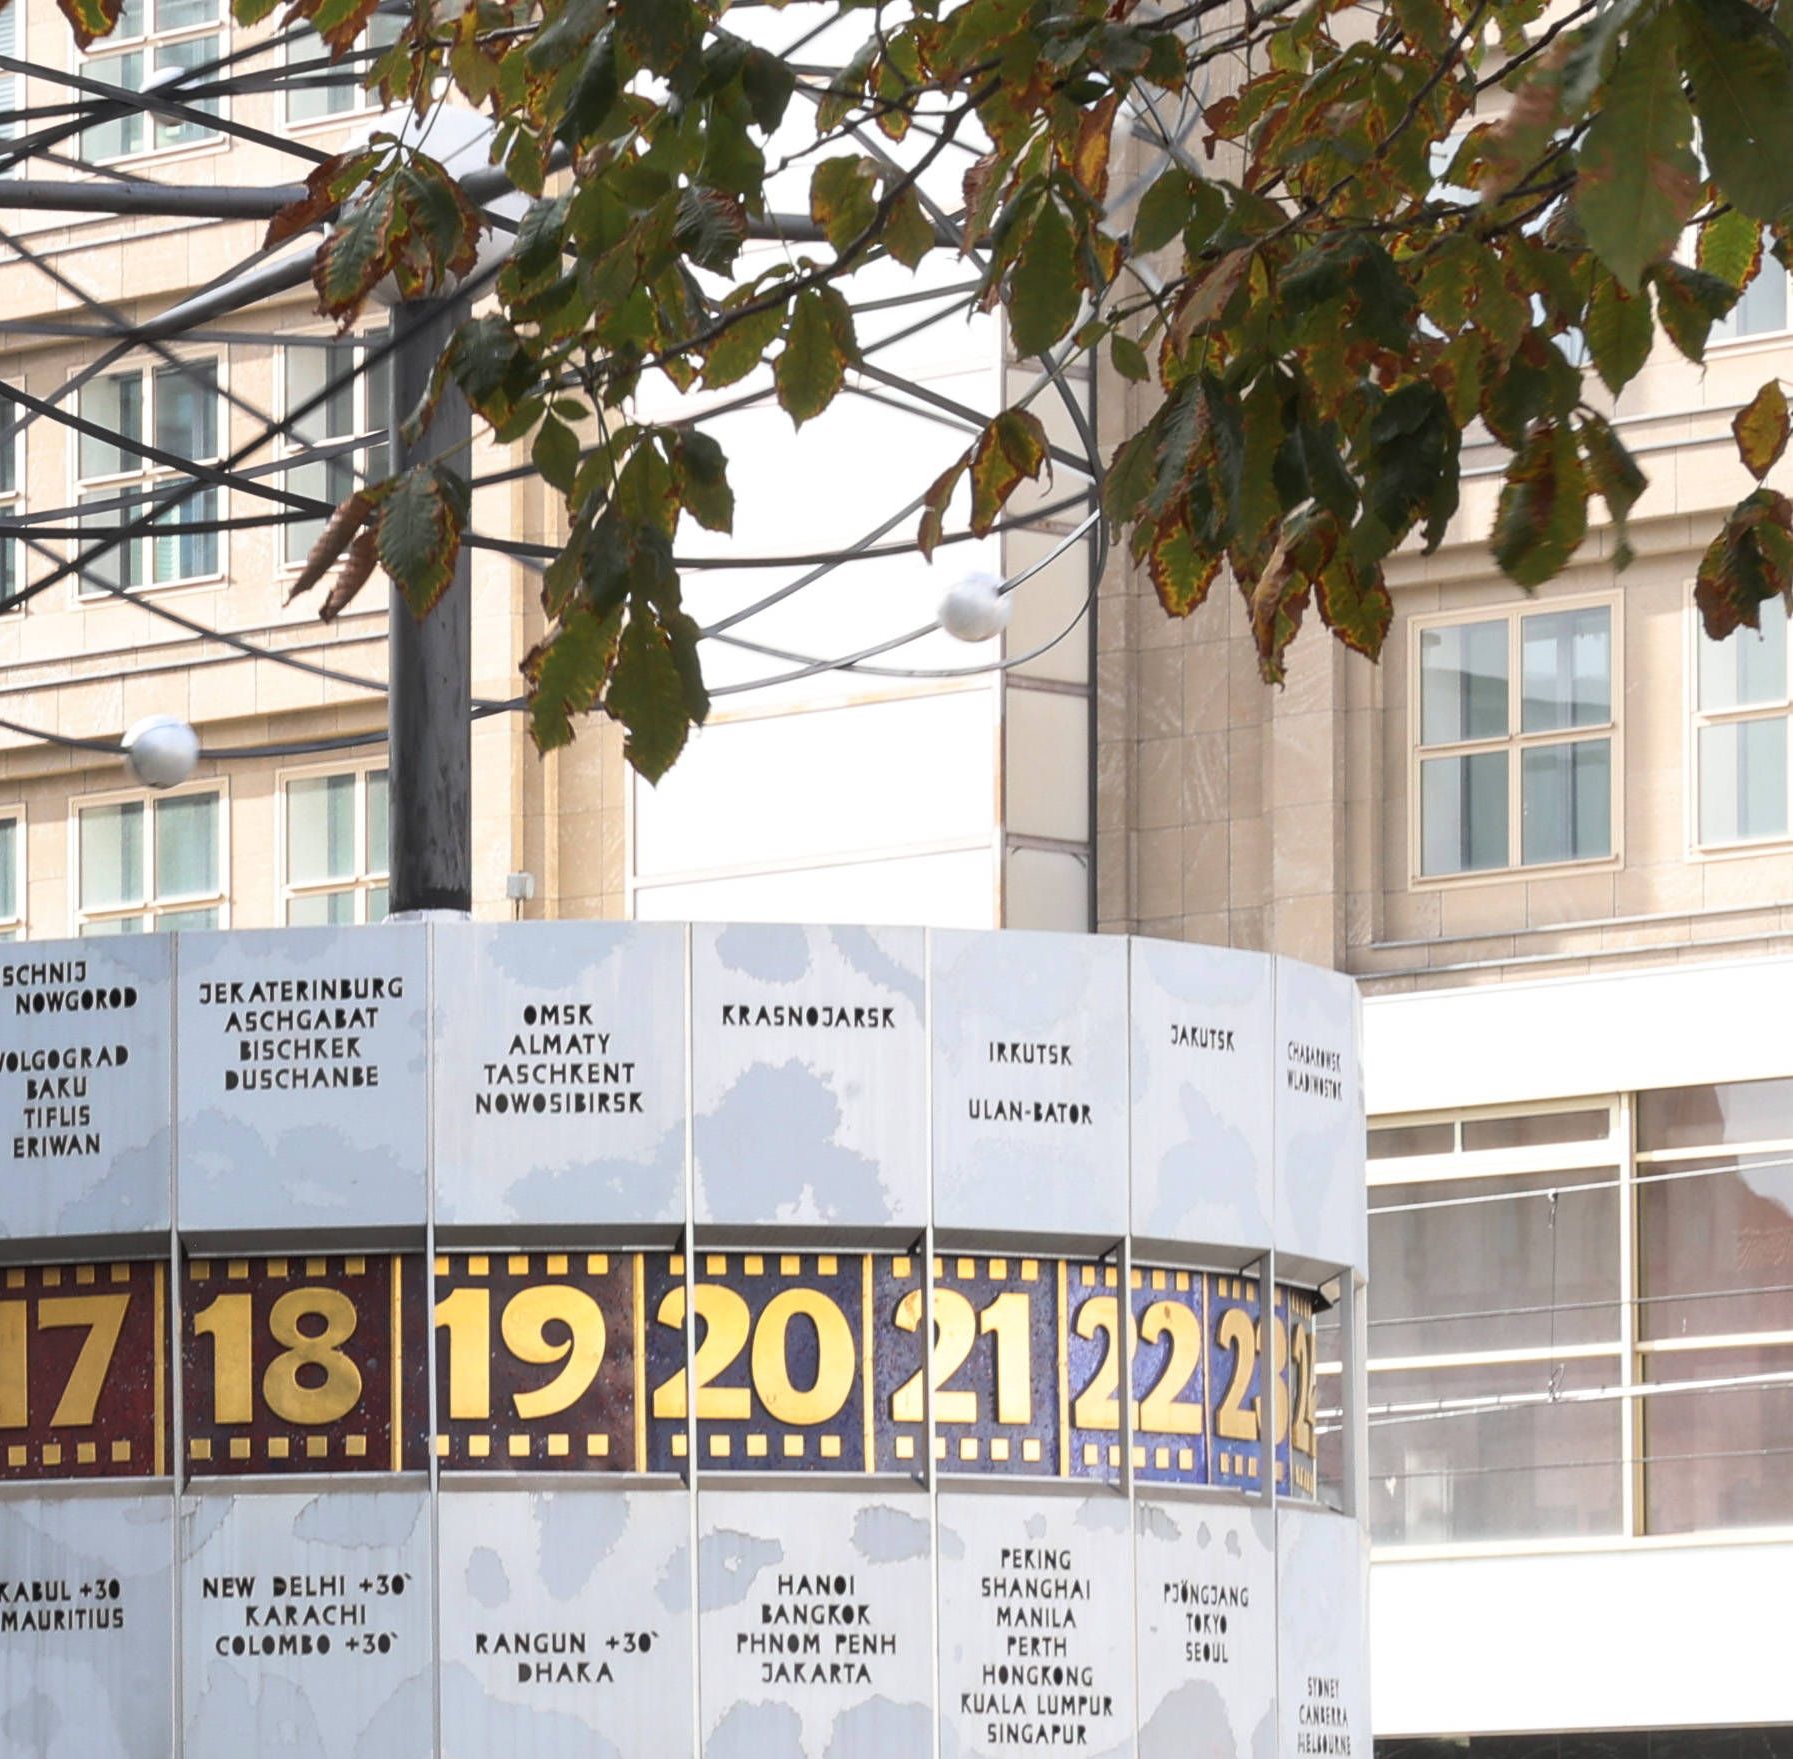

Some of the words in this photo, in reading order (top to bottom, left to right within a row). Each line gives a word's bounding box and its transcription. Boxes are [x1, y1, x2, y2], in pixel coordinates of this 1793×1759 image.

[16, 987, 137, 1015] NOWGOROD
[199, 977, 403, 1005] JEKATERINBURG
[224, 1007, 379, 1033] ASCHGABAT
[523, 1004, 593, 1026] OMSK
[722, 1004, 895, 1028] KRASNOJARSK
[240, 1036, 361, 1062] BISCHKEK
[508, 1033, 610, 1055] ALMATY
[1171, 1024, 1235, 1051] JAKUTSK
[989, 1041, 1072, 1066] IRKUTSK
[1288, 1040, 1341, 1073] CHABAROWSK
[225, 1065, 379, 1091] DUSCHANBE
[483, 1062, 635, 1085] TASCHKENT
[1287, 1065, 1342, 1100] WLADIWOSTOK
[26, 1076, 87, 1101] BAKU
[475, 1091, 643, 1114] NOWOSIBIRSK
[969, 1099, 1092, 1124] ULAN-BATOR
[23, 1104, 90, 1129] TIFLIS
[13, 1133, 100, 1159] ERIWAN
[193, 1287, 364, 1426] 18
[433, 1285, 607, 1421] 19
[653, 1284, 858, 1427] 20
[891, 1288, 1032, 1424] 21
[1074, 1296, 1204, 1434] 22
[1218, 1308, 1290, 1446] 23
[1001, 1548, 1071, 1571] PEKING
[203, 1576, 256, 1599] NEW
[272, 1575, 345, 1597] DELHI
[778, 1575, 854, 1596] HANOI
[981, 1577, 1090, 1600] SHANGHAI
[1164, 1580, 1249, 1608] PJÖNGJANG
[1, 1607, 124, 1632] MAURITIUS
[245, 1604, 366, 1627] KARACHI
[761, 1603, 870, 1625] BANGKOK
[996, 1606, 1076, 1628] MANILA
[1186, 1612, 1227, 1635] TOKYO
[215, 1634, 331, 1657] COLOMBO
[475, 1633, 586, 1654] RANGUN
[737, 1633, 821, 1654] PHNOM
[835, 1633, 896, 1655] PENH
[1007, 1635, 1067, 1657] PERTH
[1185, 1641, 1229, 1664] SEOUL
[518, 1661, 614, 1683] DHAKA
[762, 1662, 872, 1684] JAKARTA
[982, 1664, 1093, 1687] HONGKONG
[1307, 1676, 1339, 1699] SYDNEY
[961, 1693, 1027, 1715] KUALA
[1037, 1695, 1112, 1716] LUMPUR
[1299, 1704, 1347, 1726] CANBERRA
[987, 1723, 1087, 1745] SINGAPUR
[1297, 1732, 1351, 1757] MELBOURNE
